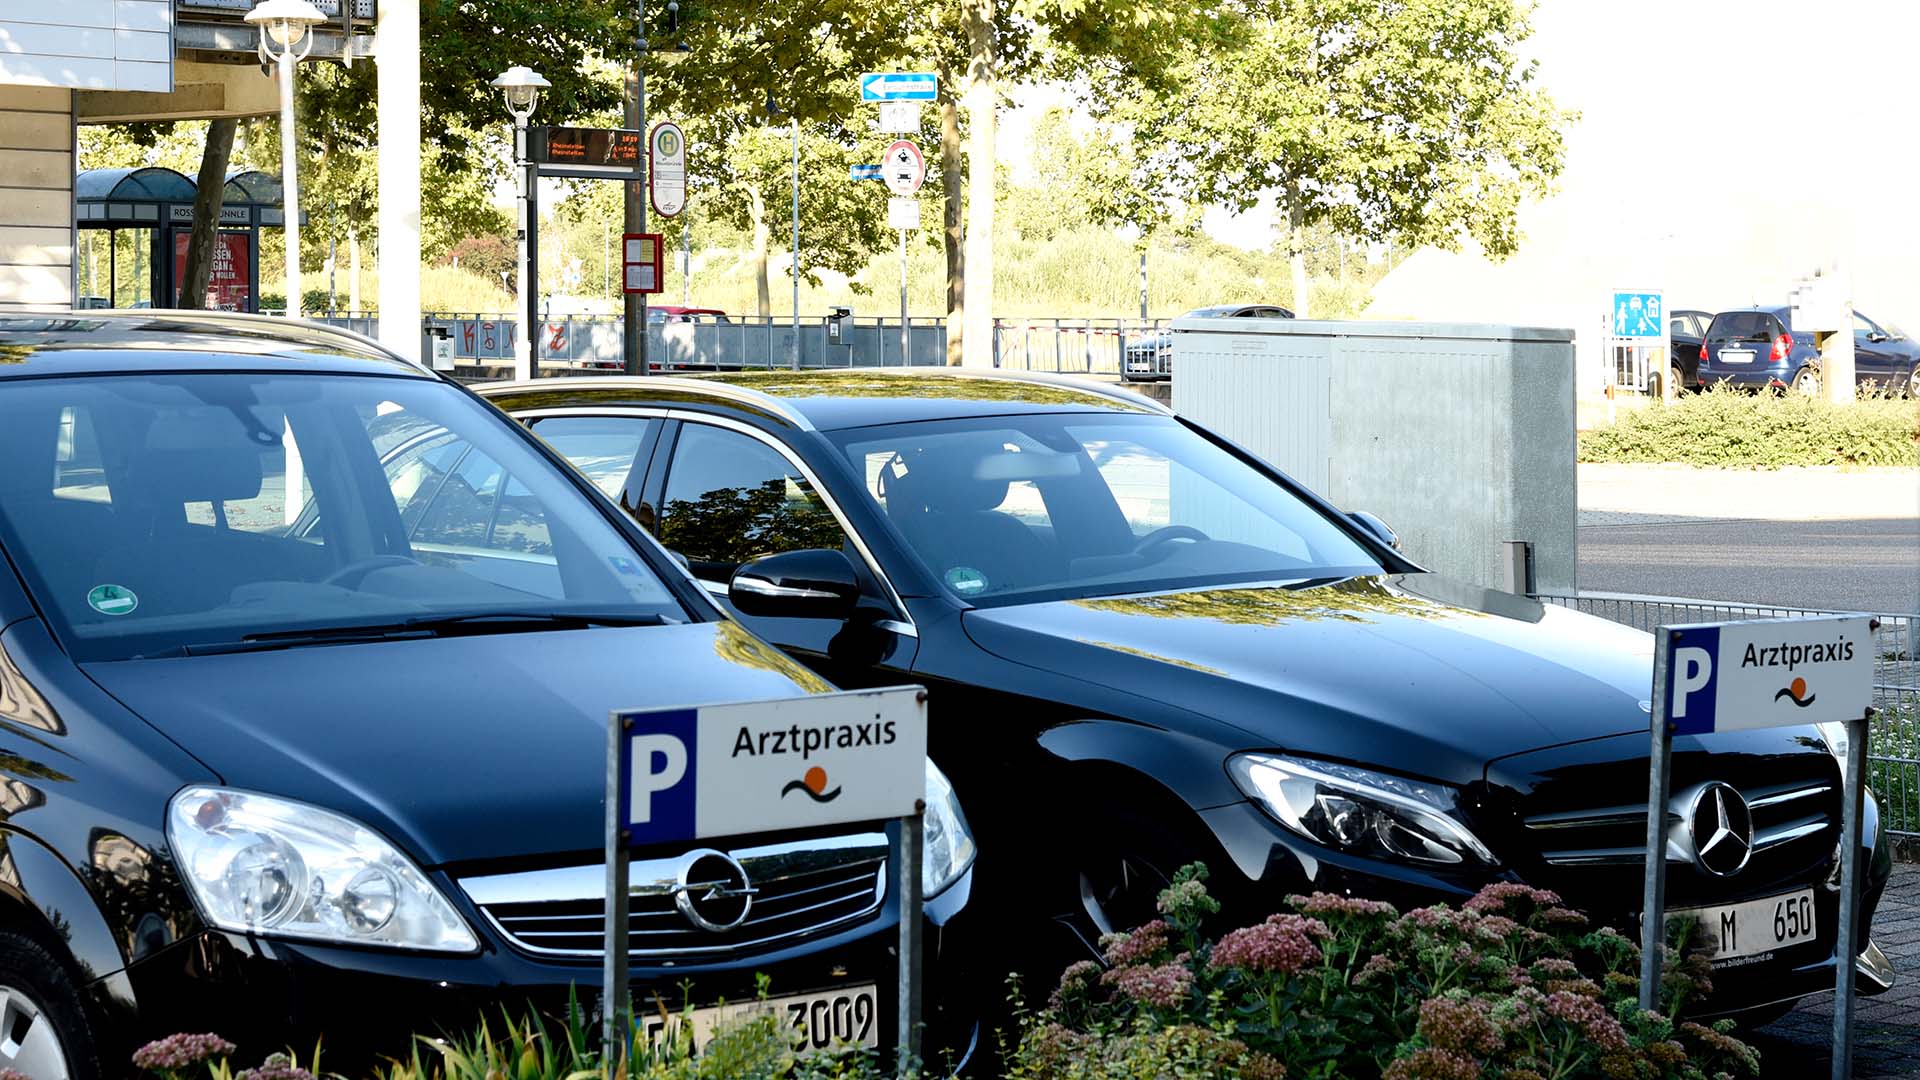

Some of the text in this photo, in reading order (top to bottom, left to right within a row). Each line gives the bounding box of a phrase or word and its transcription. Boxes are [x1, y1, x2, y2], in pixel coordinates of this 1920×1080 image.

[1672, 634, 1854, 718] P Arztpraxis
[630, 713, 896, 824] P Arztpraxis
[1720, 895, 1812, 952] M 650
[786, 993, 874, 1053] 3009
